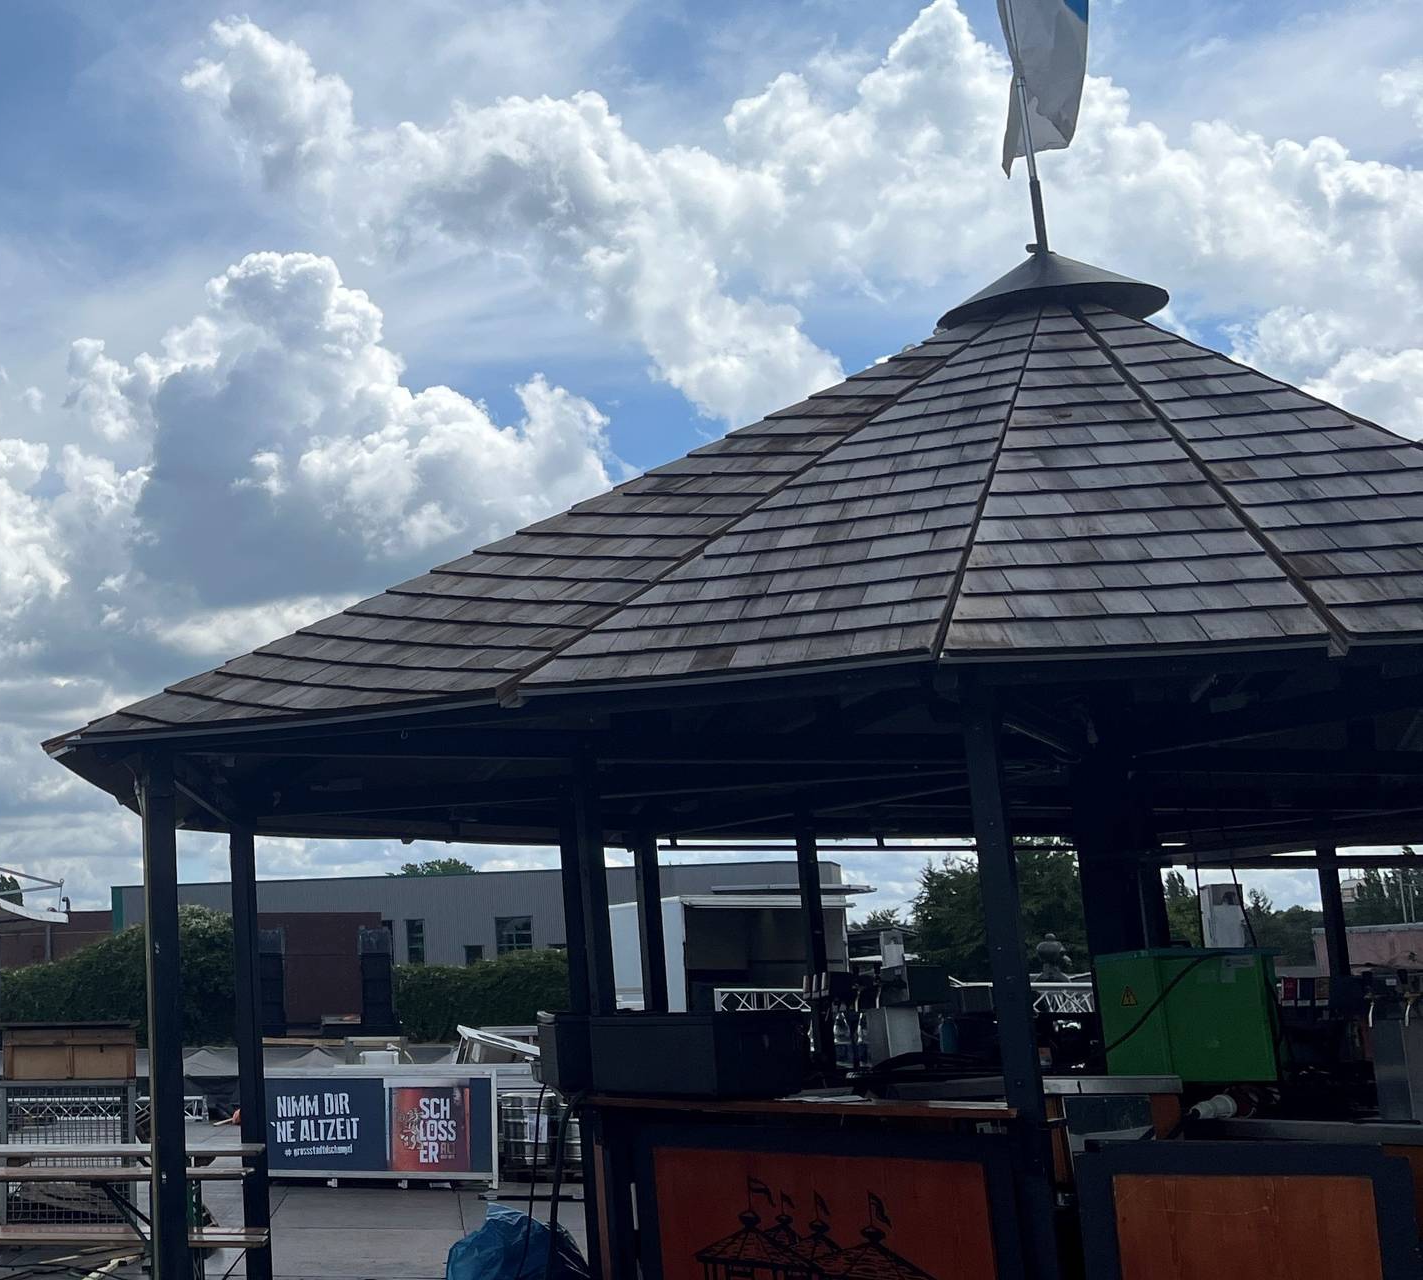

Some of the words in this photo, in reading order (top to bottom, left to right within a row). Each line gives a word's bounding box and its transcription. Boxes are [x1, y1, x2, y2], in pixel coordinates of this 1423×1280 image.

[276, 1094, 319, 1118] NIMM
[324, 1093, 350, 1115] DIR
[419, 1097, 450, 1119] SCH
[300, 1117, 360, 1141] ALTZEIT
[419, 1141, 439, 1163] ER
